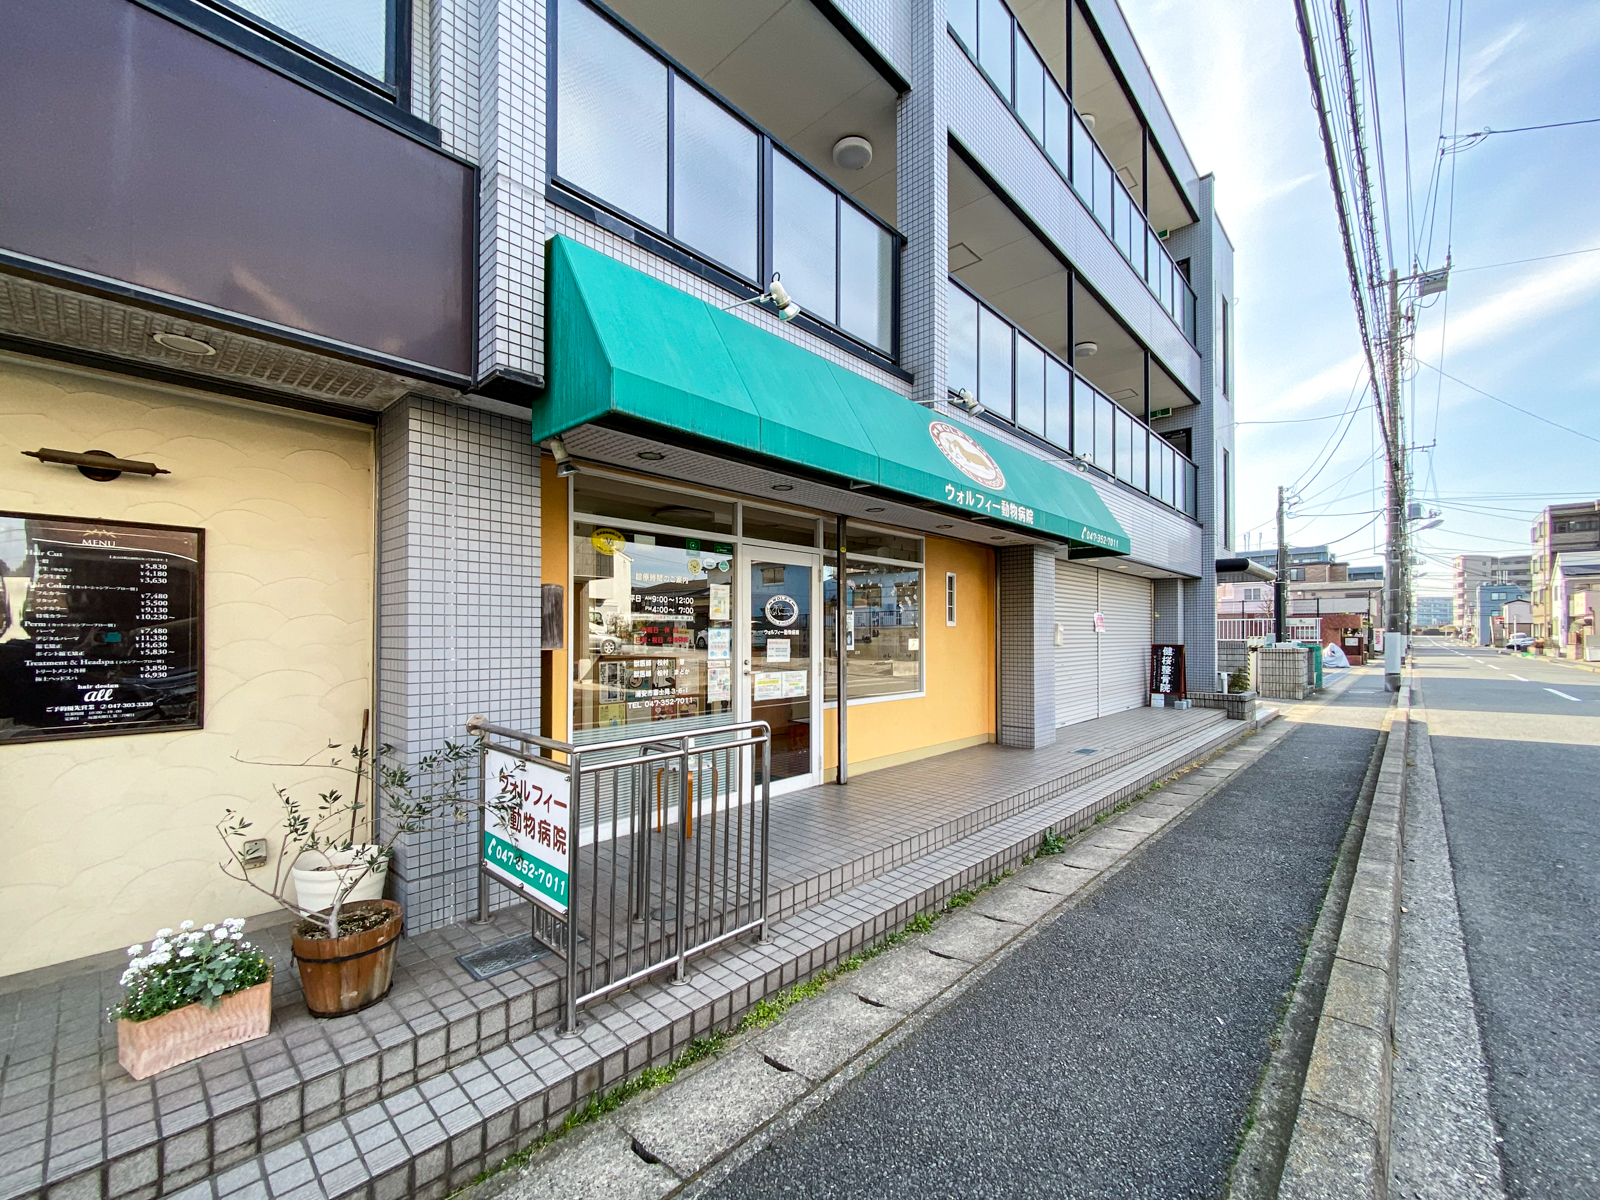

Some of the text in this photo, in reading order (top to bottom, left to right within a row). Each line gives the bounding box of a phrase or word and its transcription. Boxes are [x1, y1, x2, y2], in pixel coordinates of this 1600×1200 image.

[945, 483, 1034, 524] ウォルフィー動物病院
[82, 539, 116, 548] MENU
[1086, 531, 1119, 548] 047-352-7011
[635, 572, 689, 584] 診療時間のご案内
[80, 658, 115, 668] Headspa
[83, 688, 114, 702] all
[644, 696, 693, 708] 047-352-7011
[509, 806, 567, 856] 動物病院
[495, 845, 566, 896] 047-352-7011
